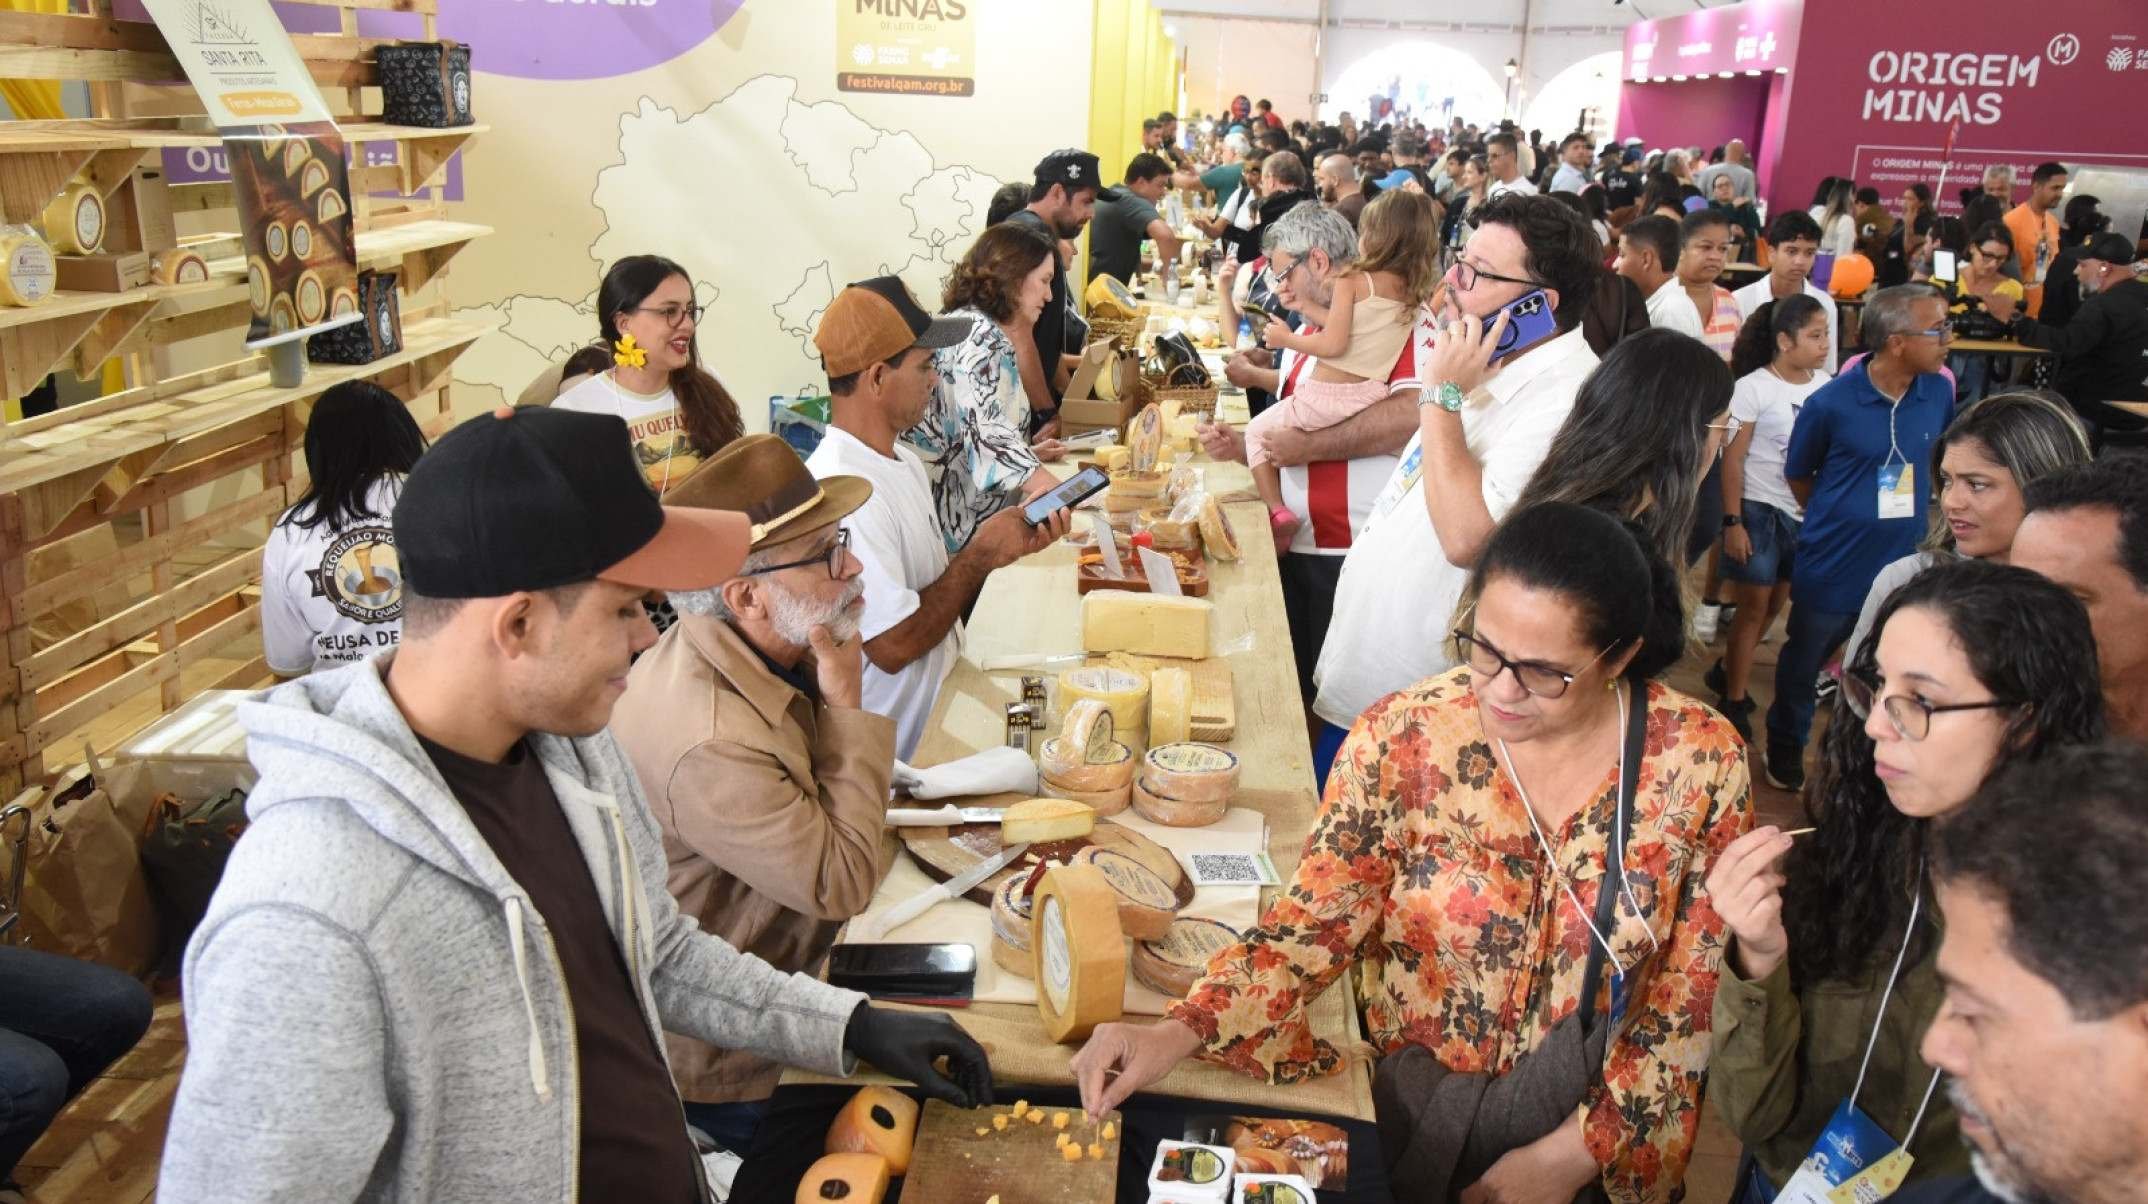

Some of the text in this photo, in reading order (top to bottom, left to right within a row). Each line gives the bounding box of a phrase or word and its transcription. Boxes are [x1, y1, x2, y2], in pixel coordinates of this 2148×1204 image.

[1868, 50, 2041, 88] ORIGEM
[846, 75, 965, 94] festivalqam.org.br
[1862, 88, 2003, 125] MINAS
[1872, 158, 1881, 168] O
[1882, 158, 1920, 168] ORIGEM
[1928, 174, 1980, 184] mieiridade
